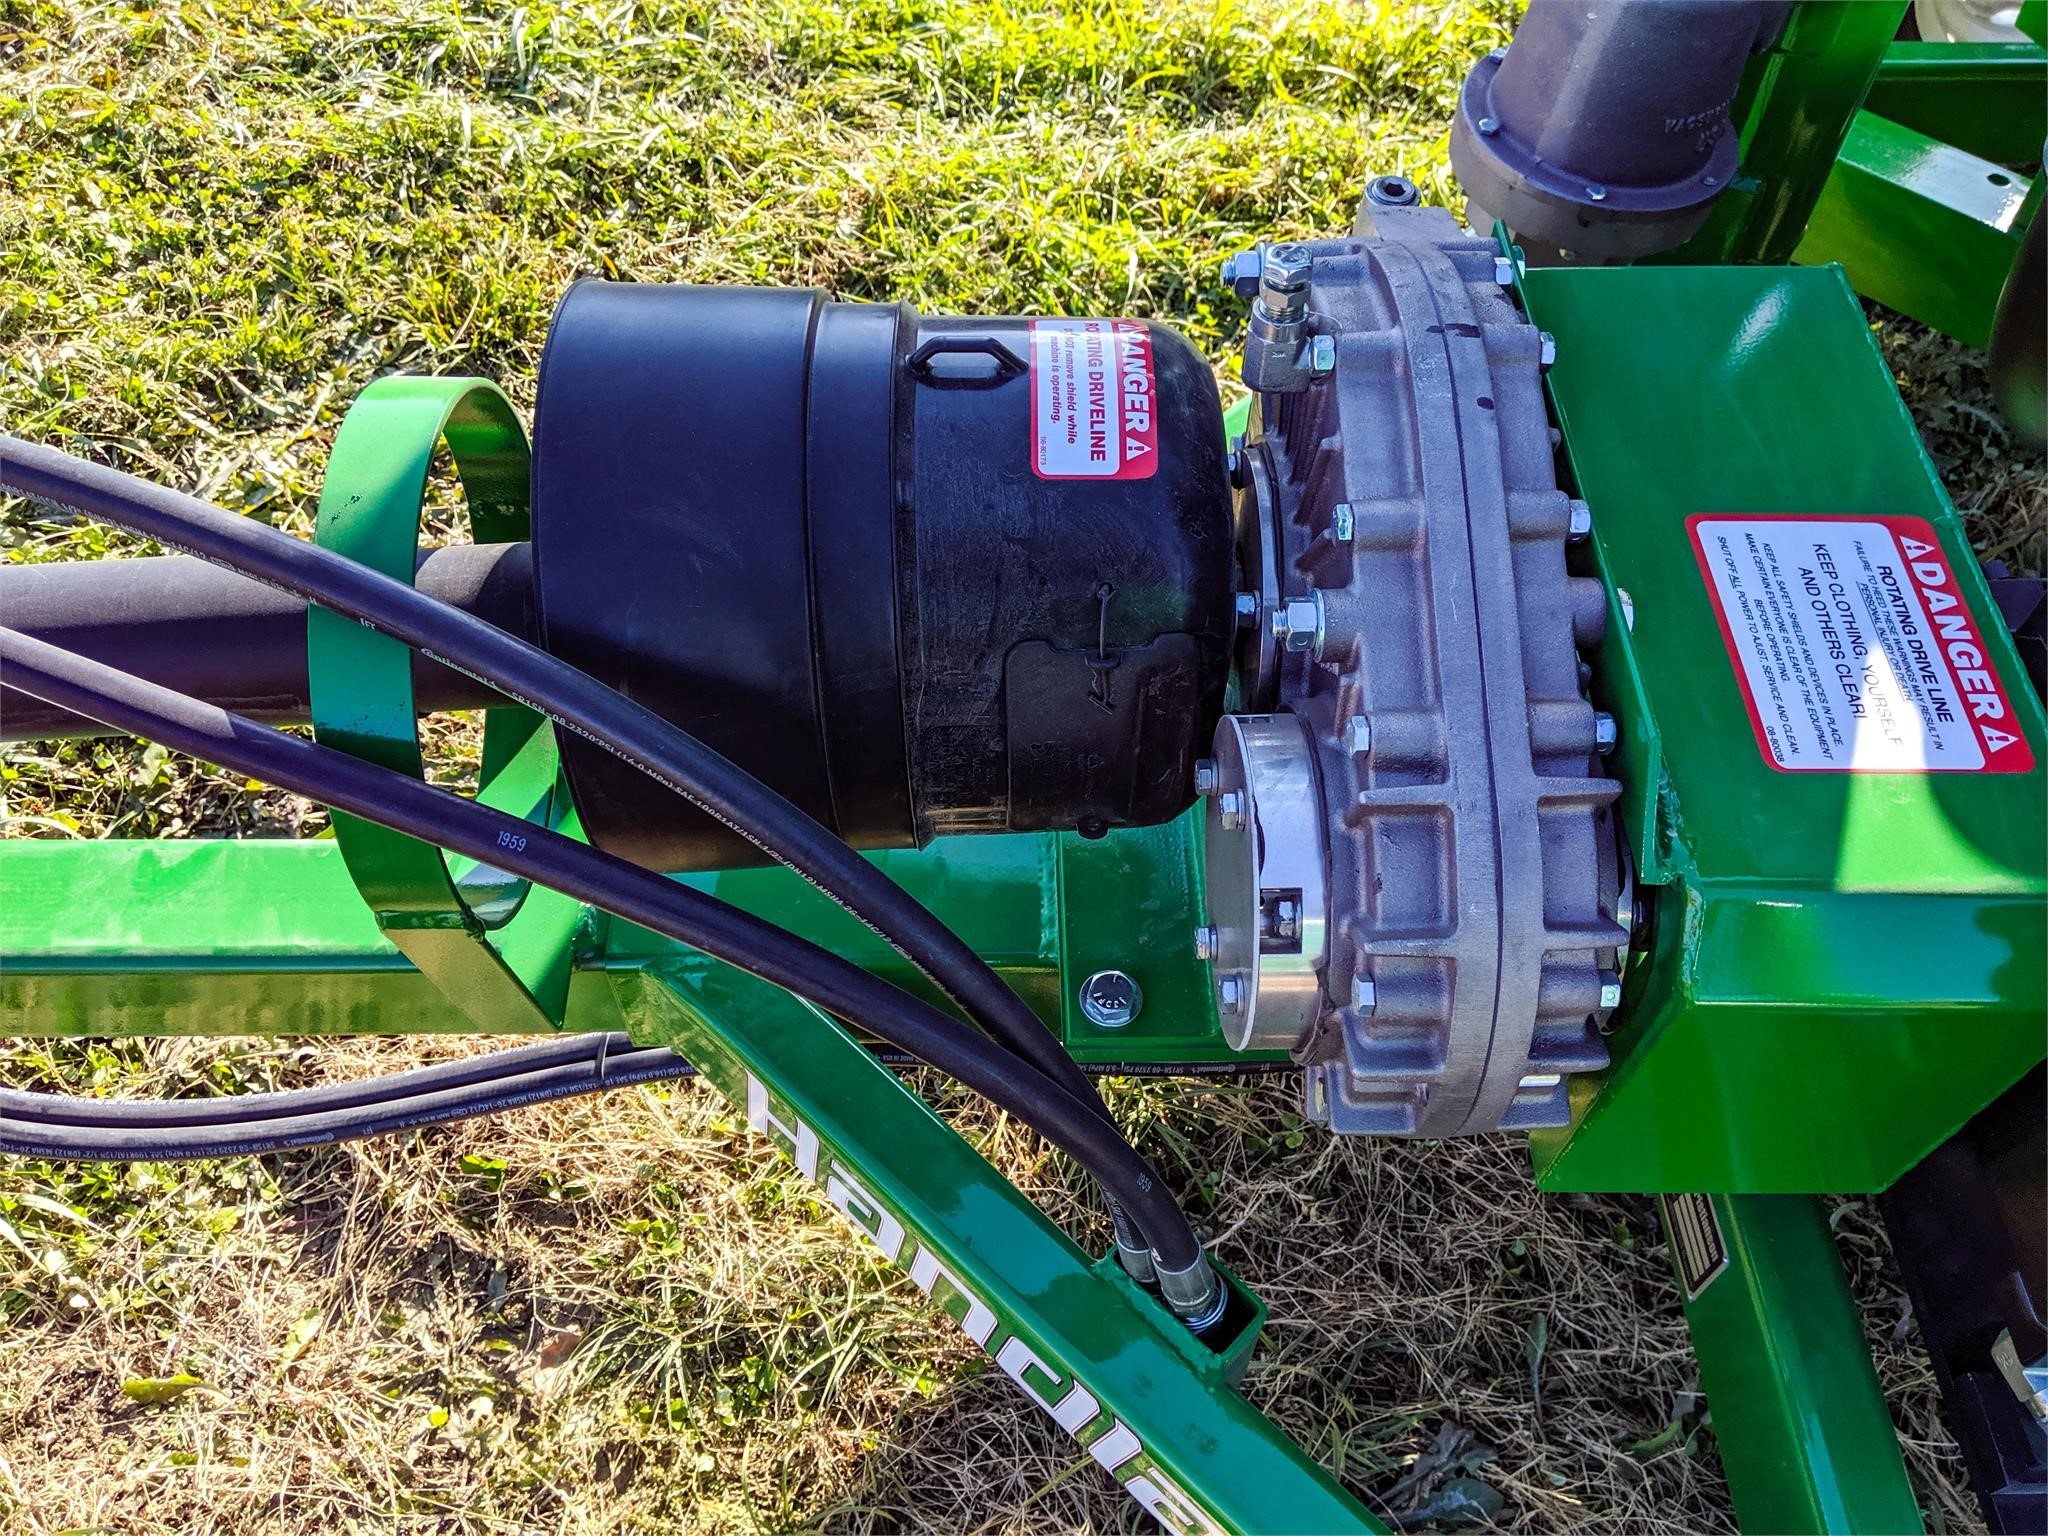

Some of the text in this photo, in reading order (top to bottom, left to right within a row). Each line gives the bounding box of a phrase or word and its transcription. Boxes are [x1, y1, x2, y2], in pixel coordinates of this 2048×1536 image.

[1052, 365, 1062, 373] is
[1065, 350, 1074, 380] remove
[1066, 382, 1077, 411] shield
[1085, 323, 1106, 462] ROATING DRIVELINE
[1120, 333, 1149, 434] DANGER
[1050, 375, 1061, 424] operating.
[1068, 414, 1077, 444] while
[1717, 536, 1732, 559] SHUT
[1762, 543, 1776, 564] KEEP
[1725, 558, 1737, 575] OFF
[1730, 574, 1742, 588] ALL
[1770, 564, 1781, 578] ALL
[1736, 590, 1754, 621] POWER
[1775, 579, 1794, 612] SAFETY
[1747, 623, 1758, 634] TO
[1754, 599, 1772, 633] BEFORE
[1787, 611, 1807, 647] SHIELDS
[1860, 583, 1882, 626] PERSONAL
[1877, 627, 1895, 657] INJURY
[1889, 657, 1901, 672] OR
[1744, 532, 1832, 759] MAKE CERTAIN EVERYONE IS CLEAR OF THE EQUIPMENT
[1798, 567, 1867, 719] AND OTHERS CLEAR!
[1812, 543, 1902, 746] KEEP CLOTHING, YOURSELF
[1853, 541, 1943, 750] FAILURE TO HEED THESE WARNINGS MAY RESULT IN
[1876, 568, 1953, 722] ROTATING DRIVE LINE
[1911, 562, 2006, 720] DANGER
[421, 647, 487, 686] Continental
[1800, 646, 1814, 667] AND
[1762, 664, 1782, 702] SERVICE
[1808, 667, 1828, 704] DEVICES
[1774, 702, 1789, 724] AND
[1821, 705, 1832, 715] IN
[497, 830, 527, 852] 1959
[1197, 1064, 1235, 1072] Continental
[289, 1132, 334, 1146] Continental
[1136, 1171, 1153, 1194] 1959
